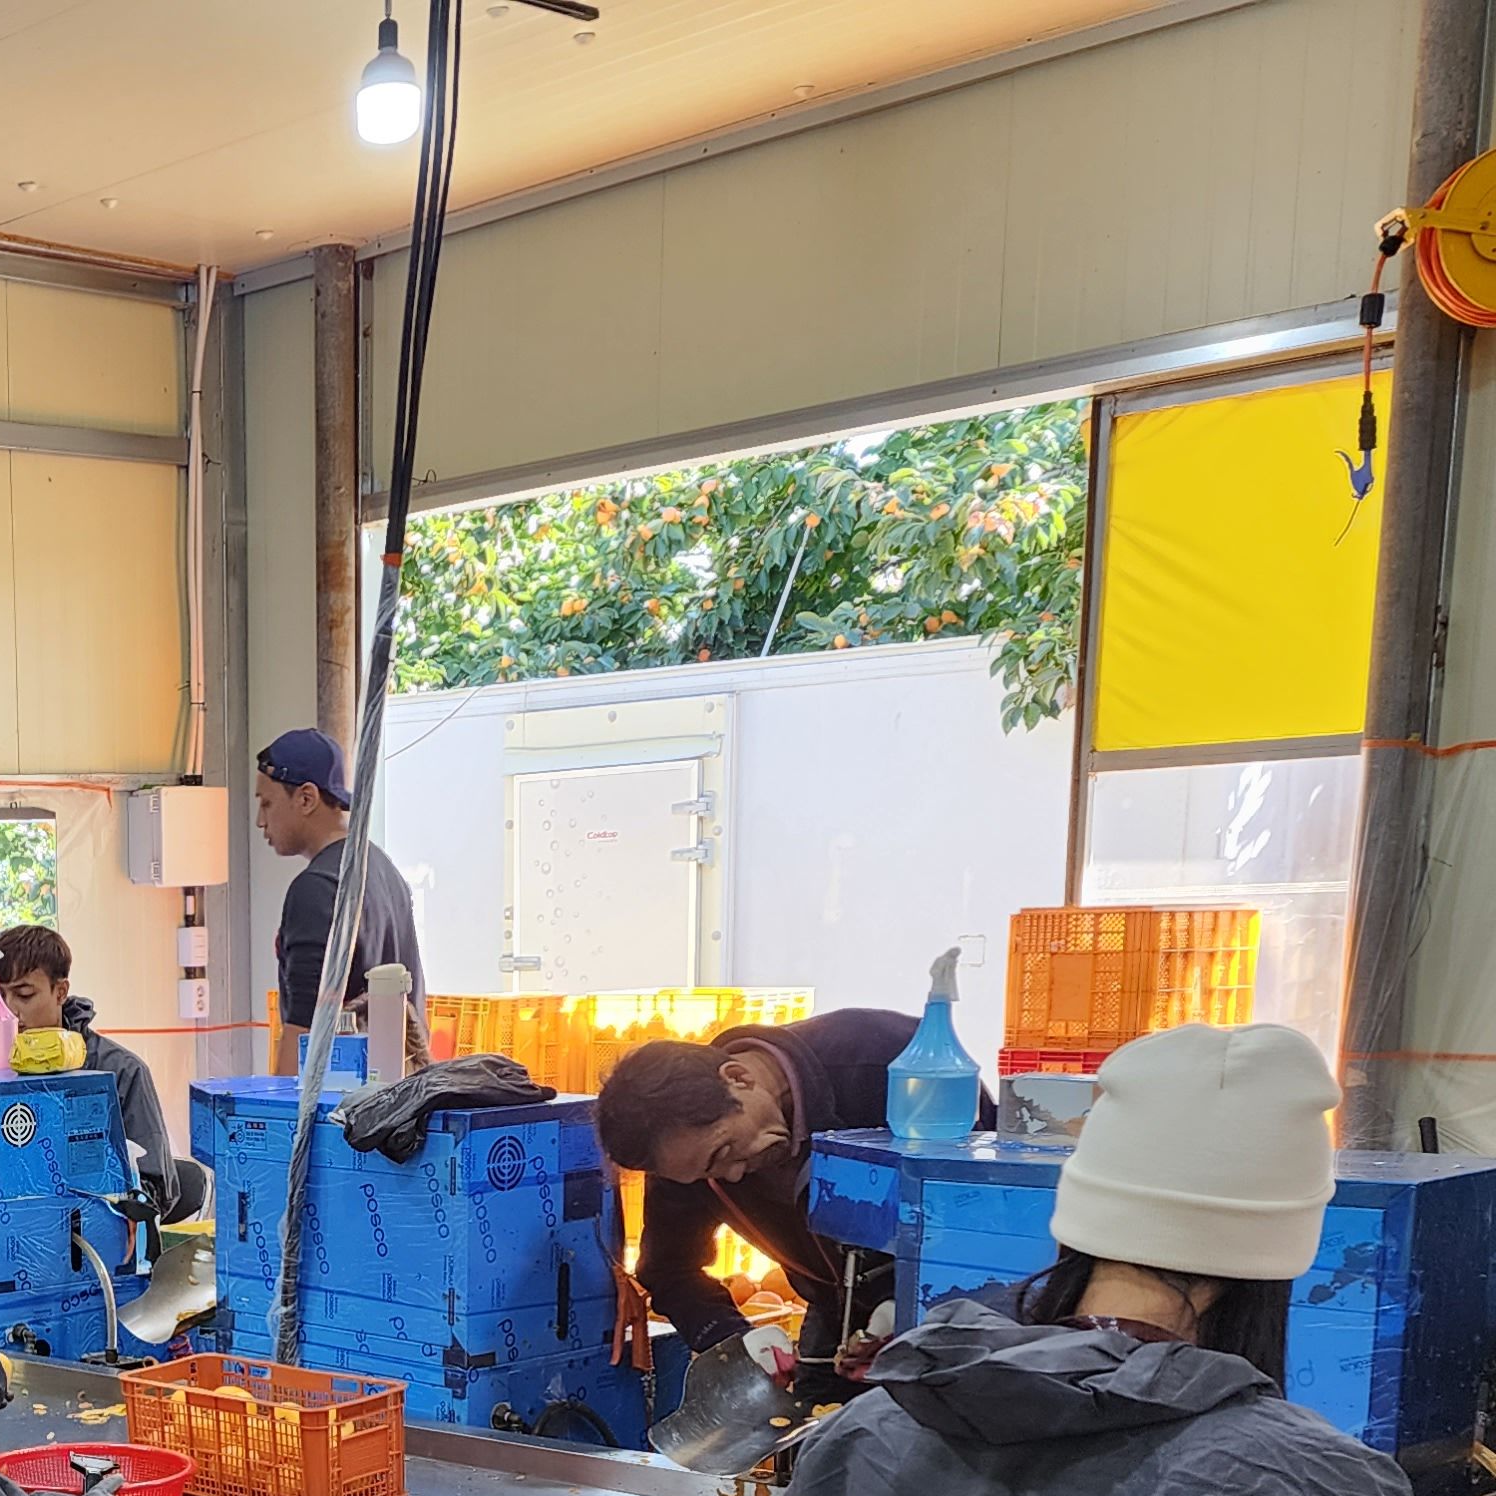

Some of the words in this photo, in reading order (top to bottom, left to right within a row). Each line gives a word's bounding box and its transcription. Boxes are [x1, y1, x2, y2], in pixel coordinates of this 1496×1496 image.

[38, 1136, 64, 1196] posco
[420, 1162, 450, 1239] posco
[528, 1155, 557, 1228] posco
[249, 1221, 275, 1292] posco
[304, 1202, 330, 1275] posco
[360, 1183, 388, 1258] posco
[469, 1191, 497, 1264] posco
[497, 1318, 519, 1362] pos
